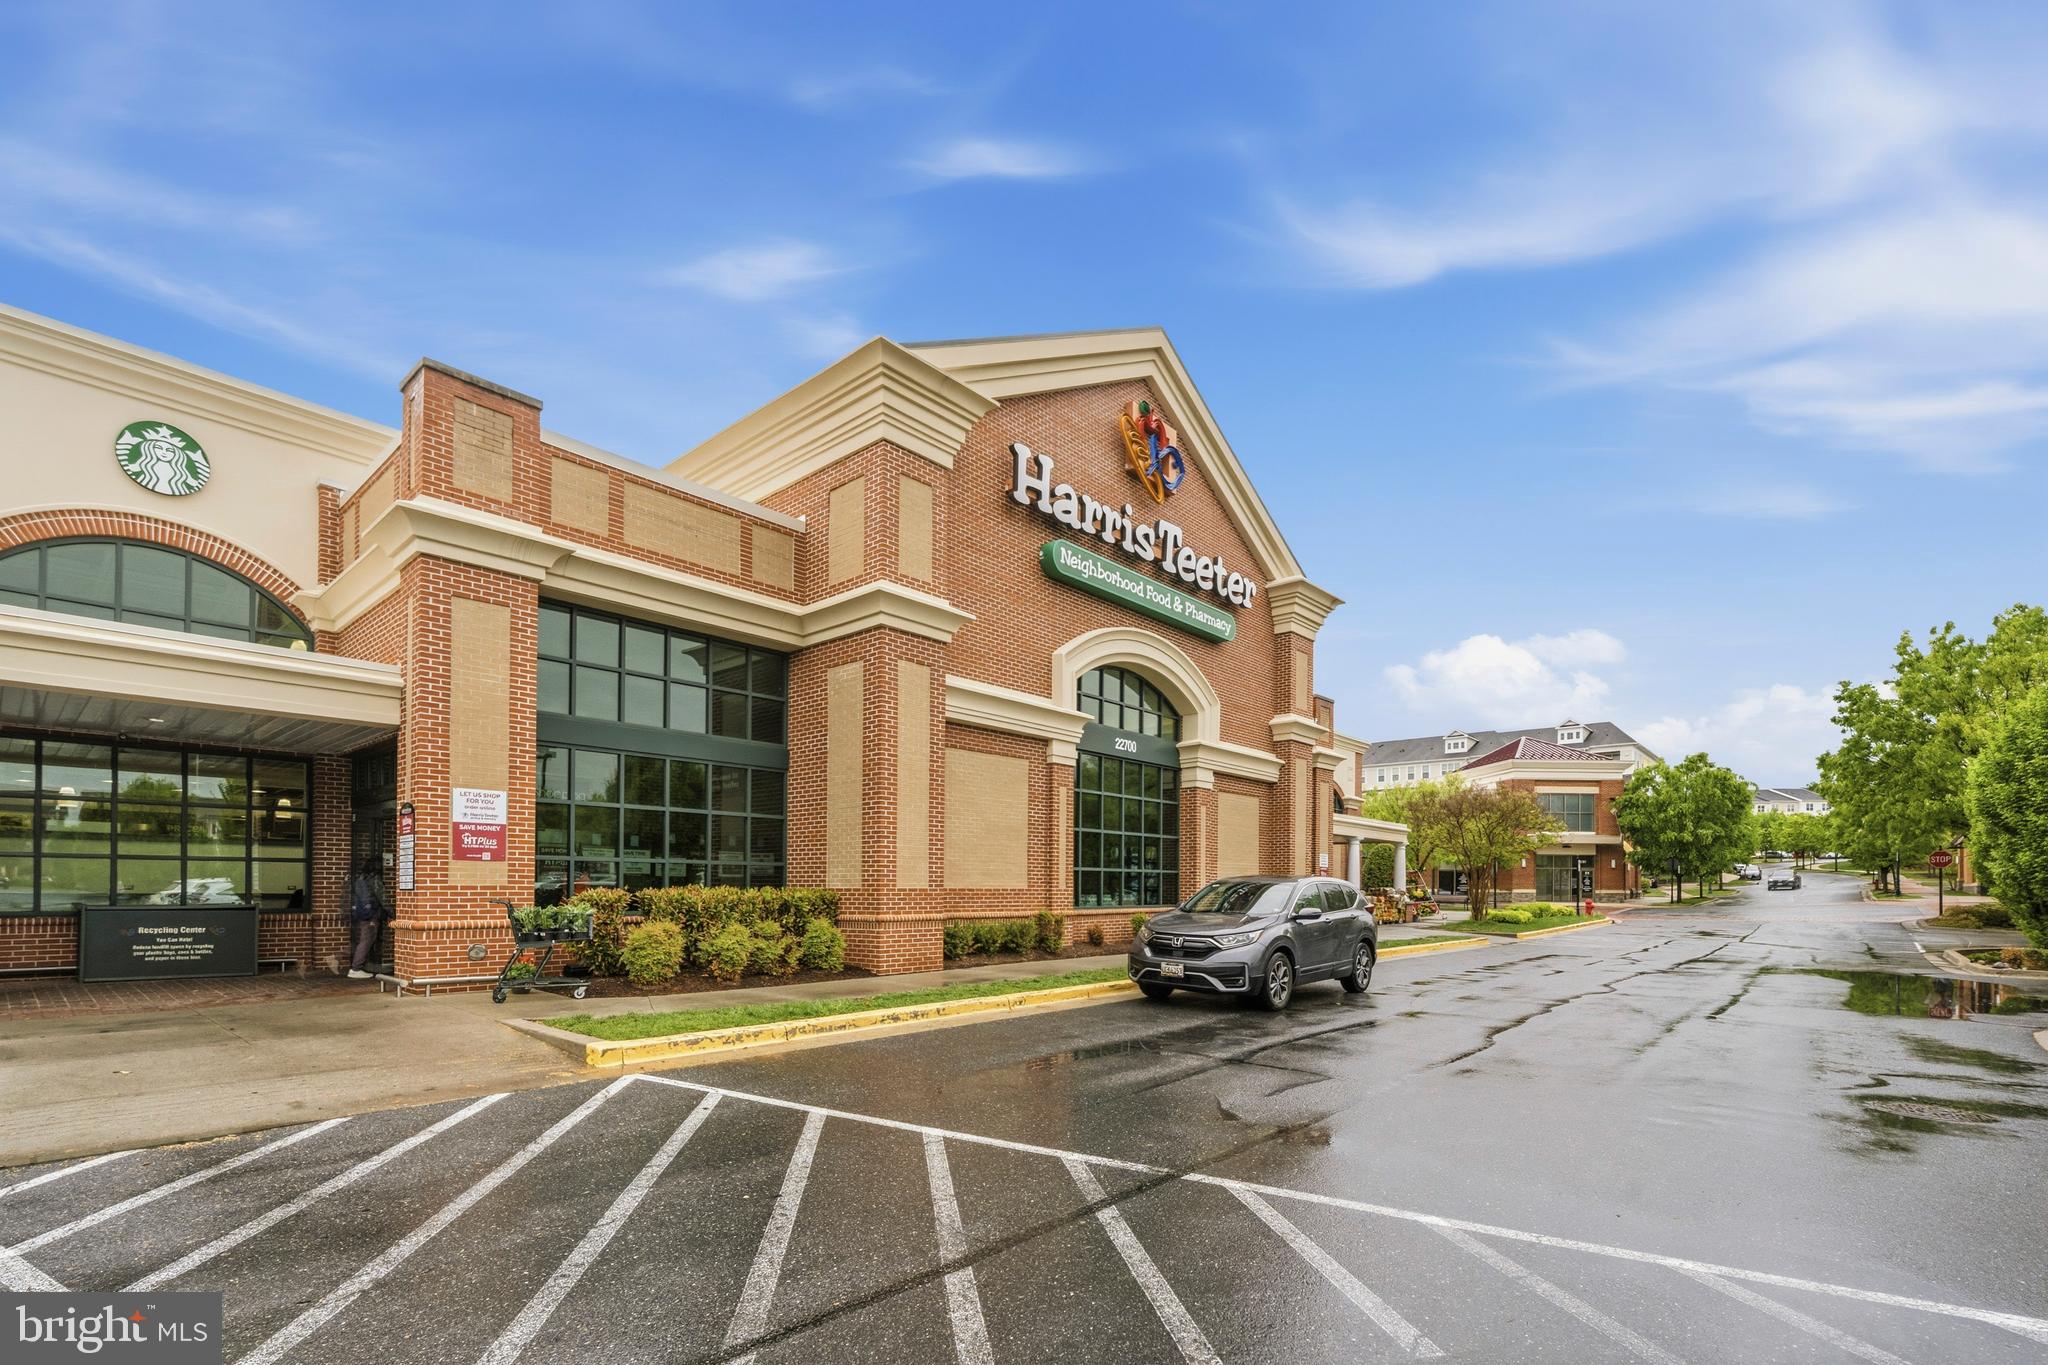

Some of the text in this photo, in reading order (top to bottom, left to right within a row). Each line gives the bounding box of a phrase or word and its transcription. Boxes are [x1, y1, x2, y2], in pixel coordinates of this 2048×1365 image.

[1060, 546, 1232, 636] Neighborhood Food & Pharmacy
[1114, 737, 1137, 753] 22700
[1930, 855, 1952, 864] STOP
[138, 926, 206, 935] Recycling Center
